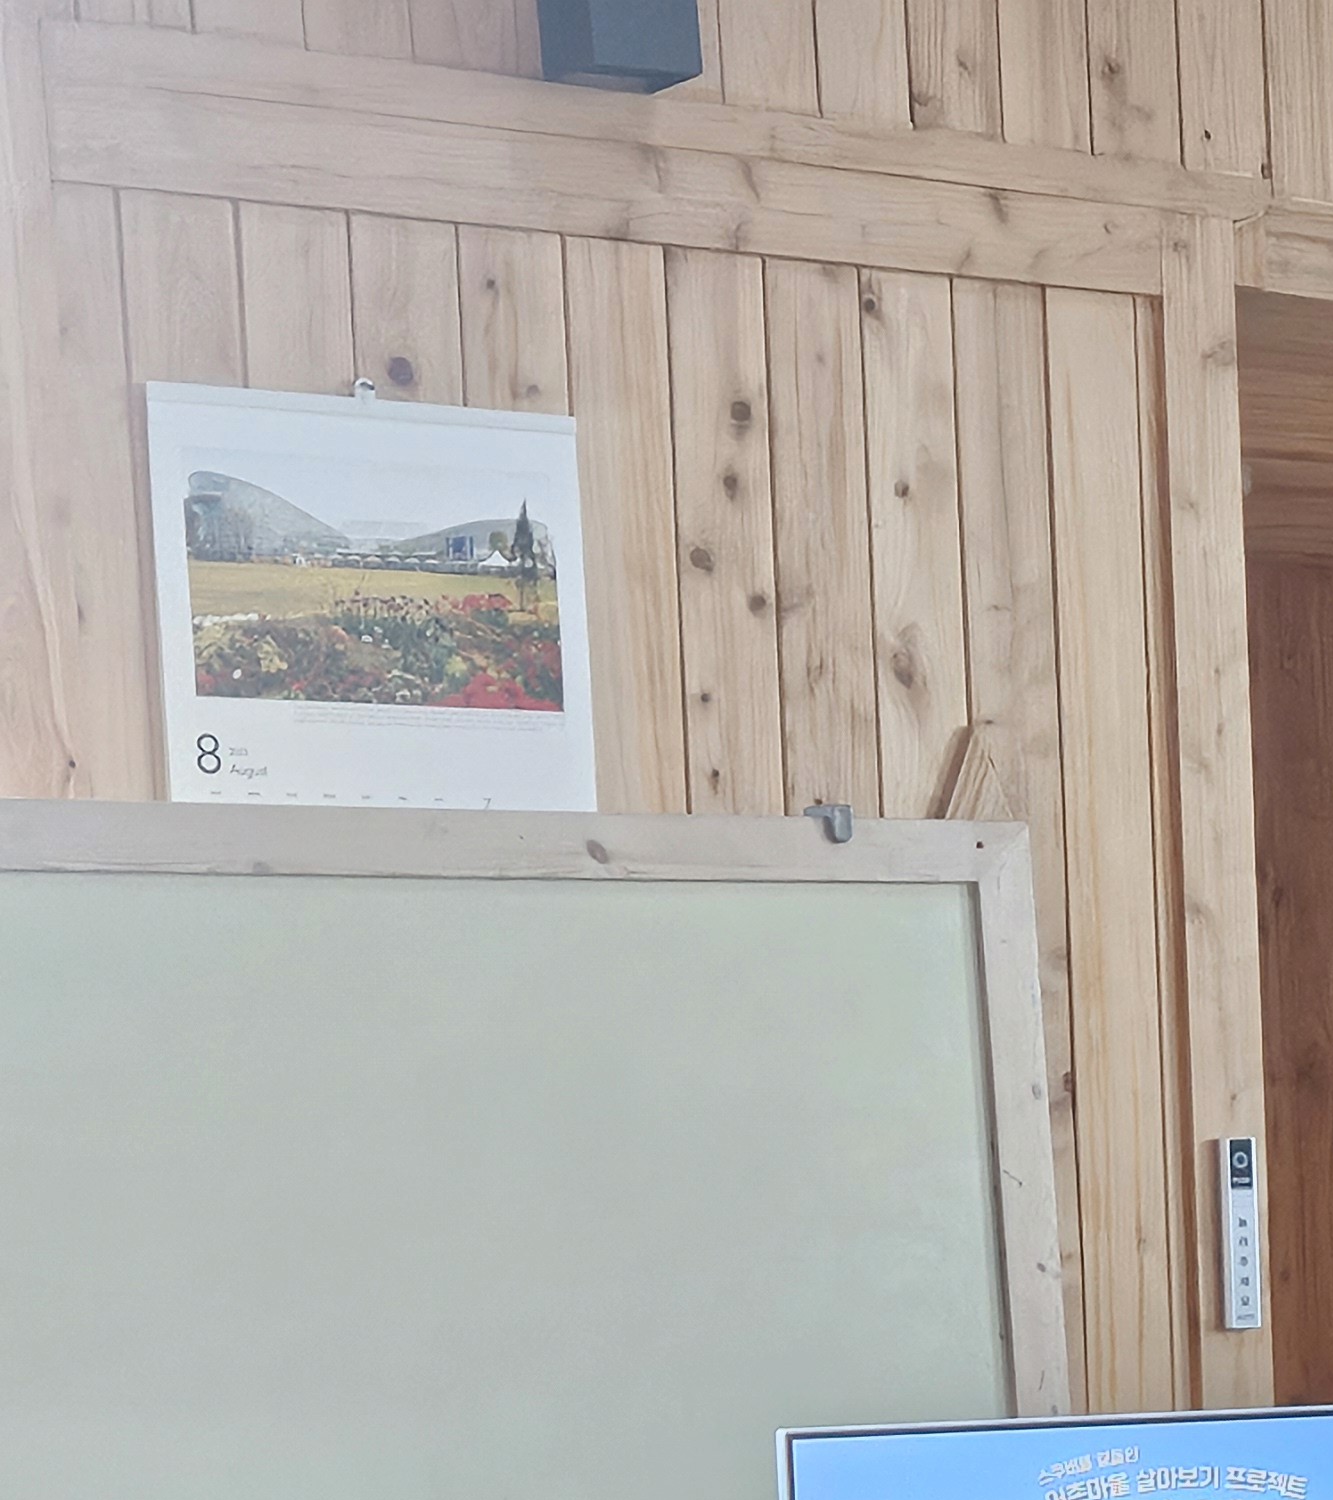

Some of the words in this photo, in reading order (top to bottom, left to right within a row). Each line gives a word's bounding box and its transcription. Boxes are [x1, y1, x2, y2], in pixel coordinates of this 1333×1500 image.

[197, 733, 221, 774] 8
[1136, 1466, 1221, 1494] 살아보기
[1224, 1466, 1309, 1500] 프로젝트
